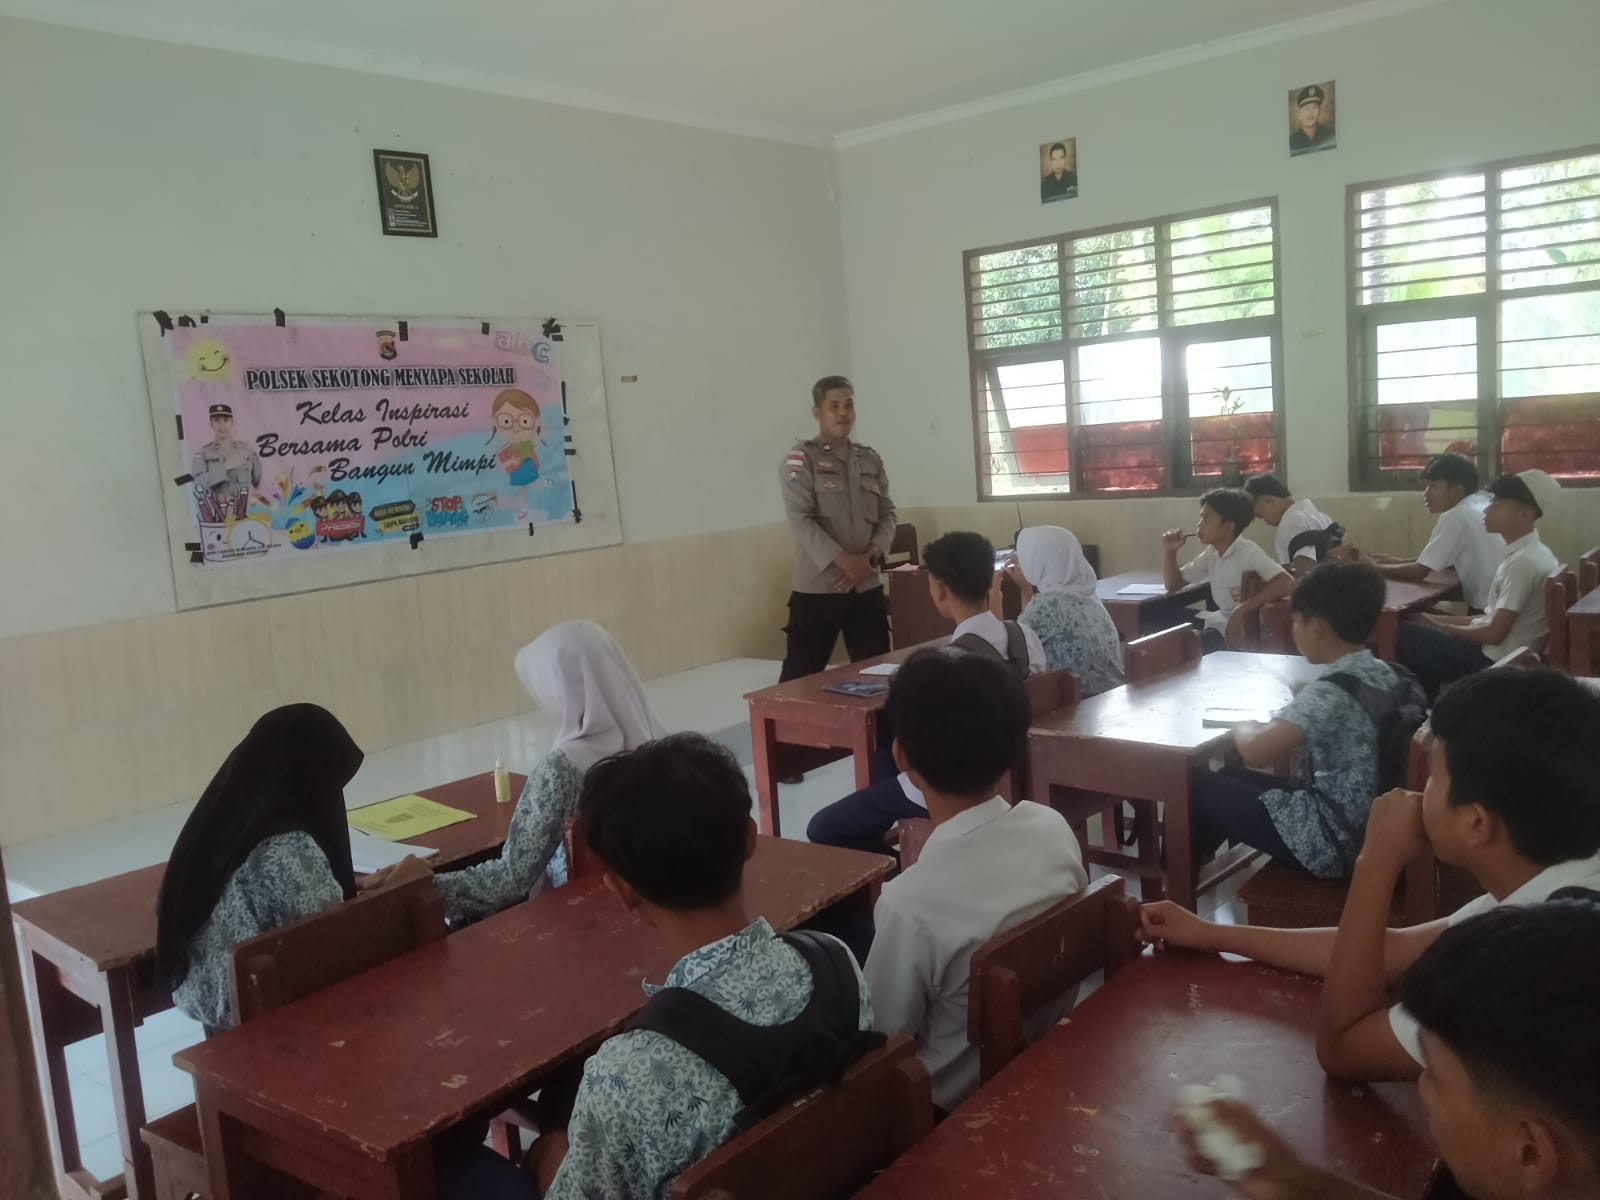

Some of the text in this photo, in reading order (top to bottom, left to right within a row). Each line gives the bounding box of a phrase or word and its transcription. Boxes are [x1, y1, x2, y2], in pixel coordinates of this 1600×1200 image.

[246, 367, 515, 390] POLSEK SEKOTONG MENYAPA SEKOLAH
[296, 398, 469, 425] Kelas Inspirasi
[256, 426, 428, 458] Bersama Polri
[328, 451, 497, 484] Bangun Mimpi
